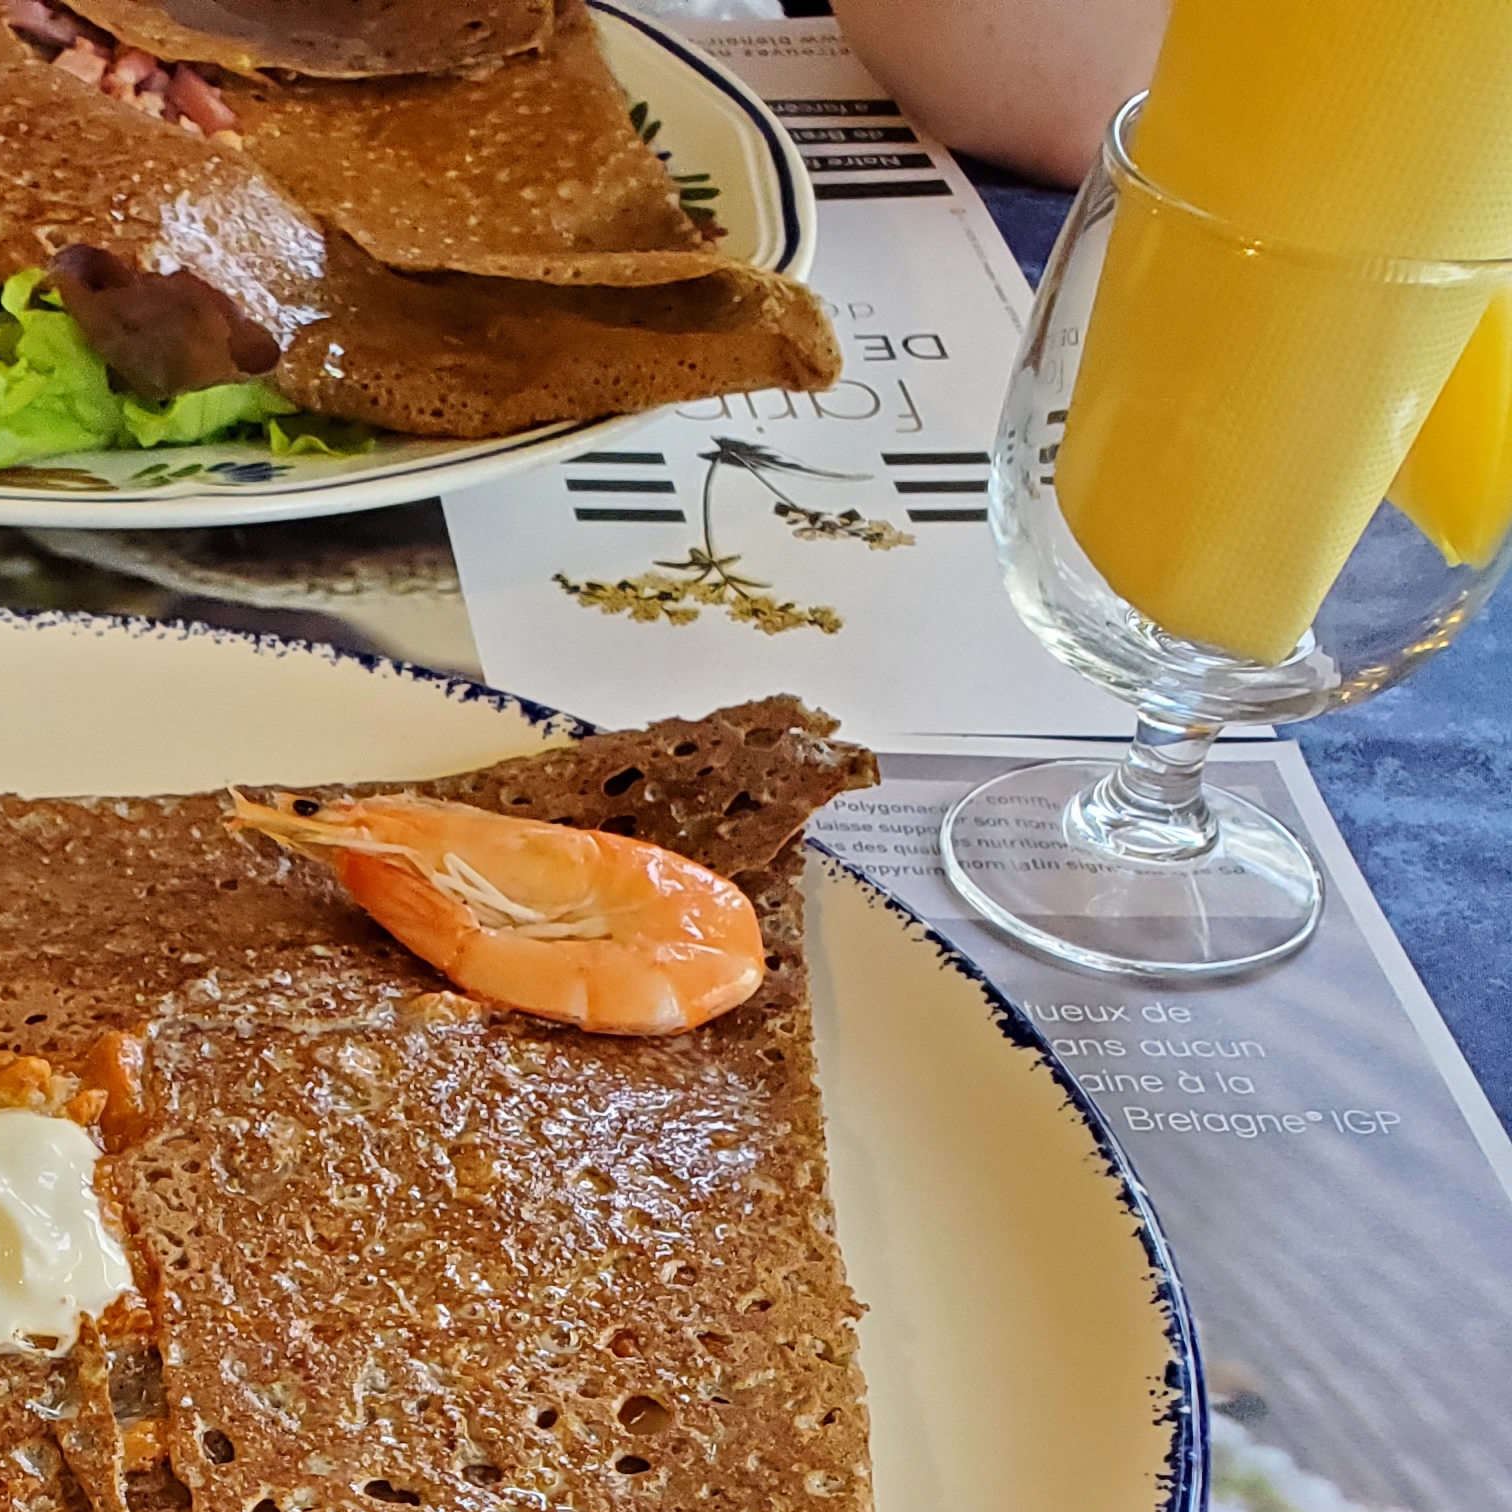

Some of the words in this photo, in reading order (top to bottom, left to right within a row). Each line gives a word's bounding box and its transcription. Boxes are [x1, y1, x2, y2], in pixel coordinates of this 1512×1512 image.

[853, 333, 950, 362] DE
[816, 819, 873, 833] laisse
[852, 840, 888, 853] des
[1009, 857, 1061, 873] latin
[1140, 1002, 1192, 1024] de
[1051, 1038, 1127, 1057] ans
[1140, 1038, 1266, 1059] aucun
[1078, 1070, 1164, 1094] aine
[1178, 1069, 1206, 1094] à
[1215, 1070, 1256, 1095] la
[1330, 1109, 1402, 1135] IGP
